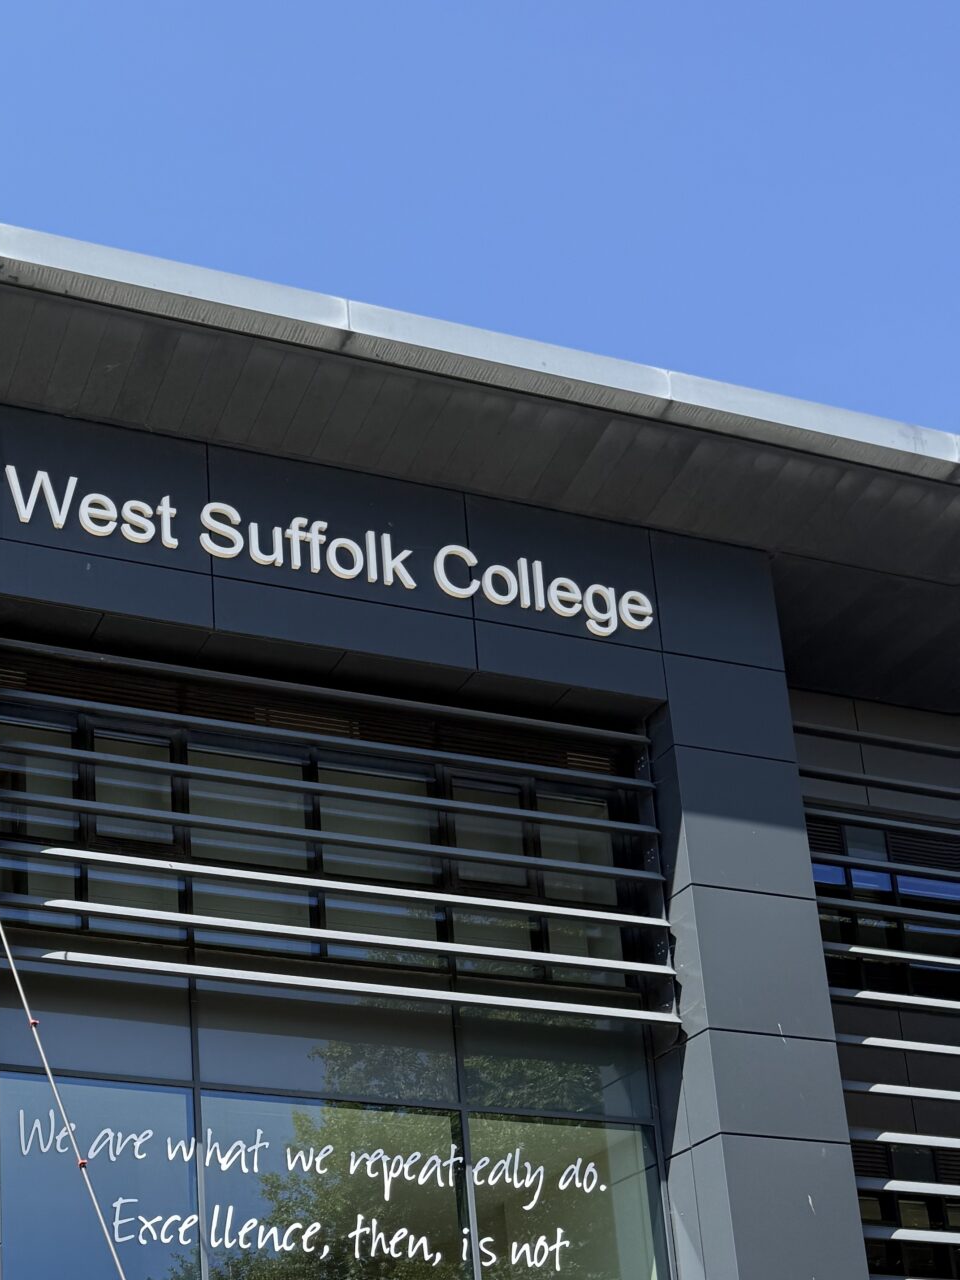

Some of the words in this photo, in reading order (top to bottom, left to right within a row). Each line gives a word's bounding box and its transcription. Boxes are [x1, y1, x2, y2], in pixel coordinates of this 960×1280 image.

[5, 464, 178, 549] West
[199, 501, 417, 590] Suffolk
[432, 544, 653, 636] College
[19, 1109, 76, 1156] We
[88, 1128, 153, 1162] are
[167, 1128, 269, 1173] what
[286, 1144, 334, 1174] we
[349, 1144, 544, 1210] repeatedly
[558, 1158, 607, 1193] do.
[112, 1197, 330, 1260] Excellence,
[348, 1214, 442, 1266] then,
[462, 1228, 497, 1266] is
[511, 1227, 570, 1272] not
